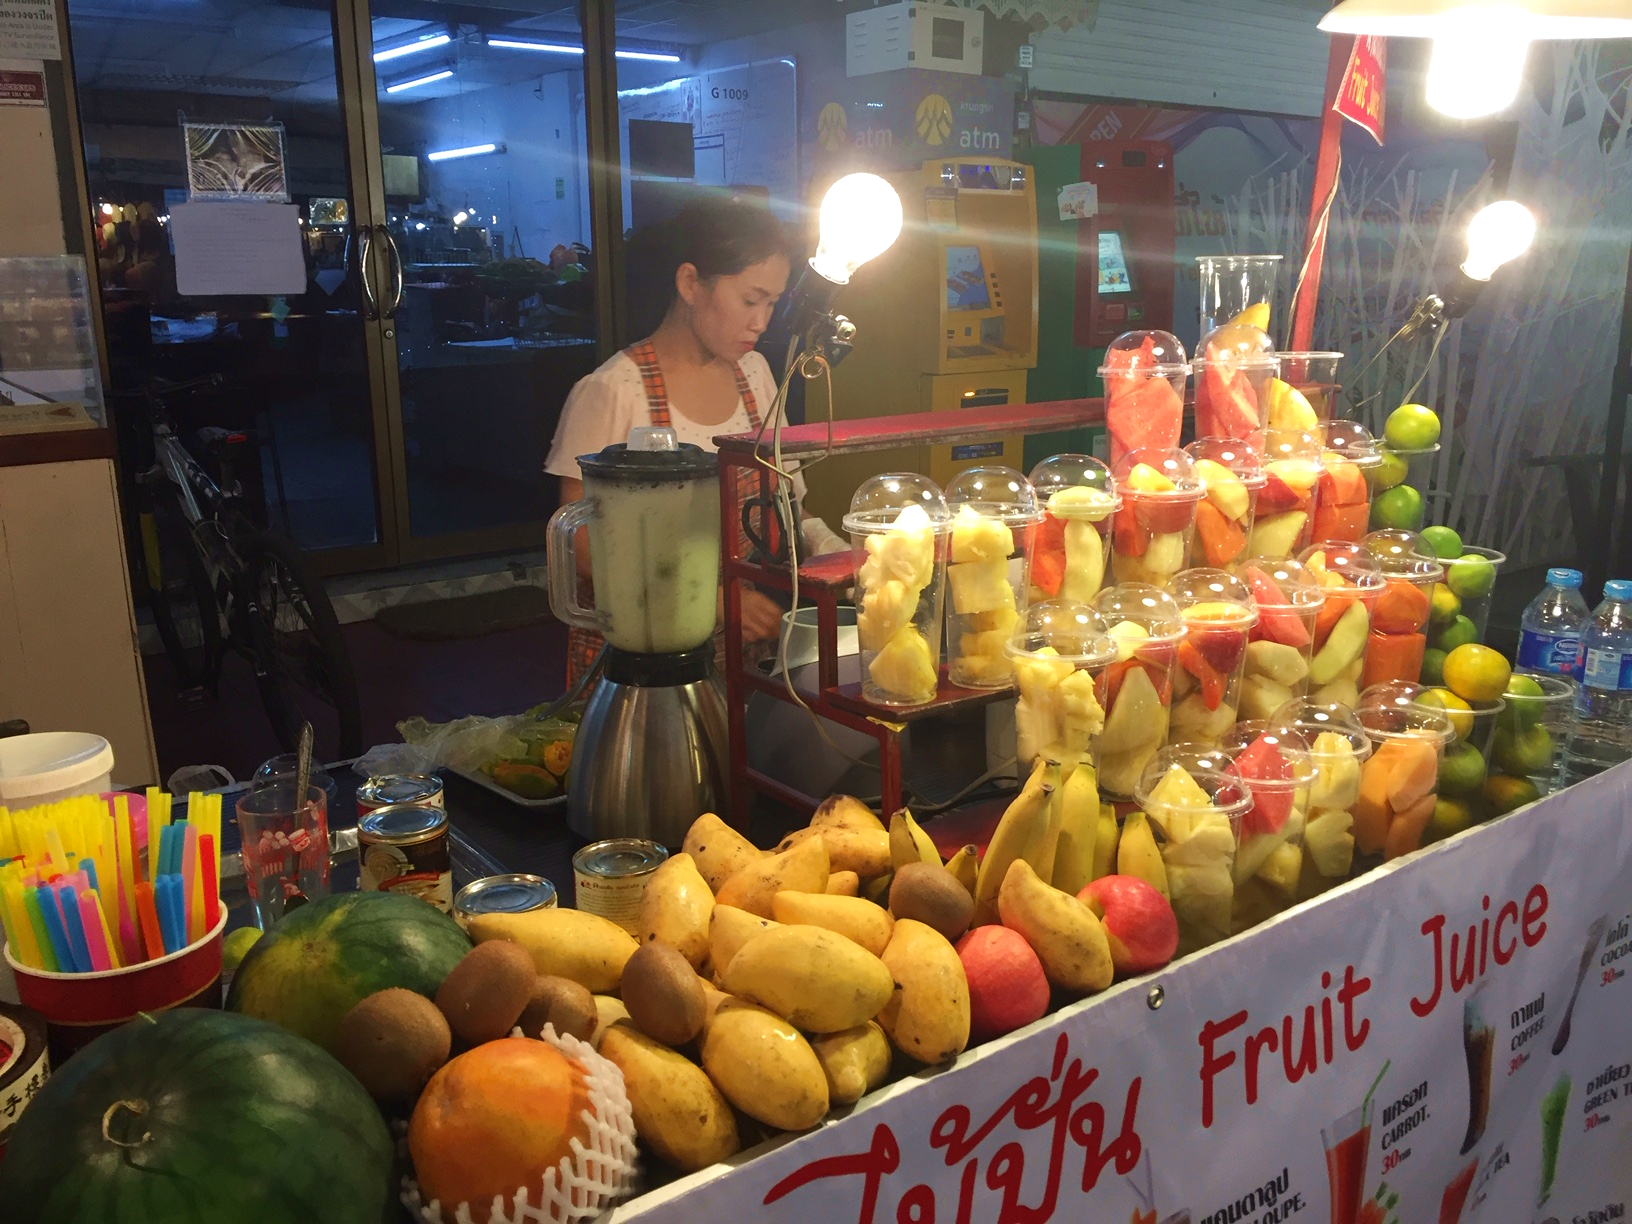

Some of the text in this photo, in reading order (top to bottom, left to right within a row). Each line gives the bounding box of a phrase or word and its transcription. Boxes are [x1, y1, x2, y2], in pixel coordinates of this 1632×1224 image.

[711, 87, 749, 101] G 1009
[855, 126, 893, 150] atm
[959, 126, 1000, 149] atm
[1198, 884, 1549, 1129] Fruit Juice
[1510, 1014, 1547, 1051] COFFEE
[1584, 1087, 1618, 1115] GREEN
[1381, 1104, 1431, 1150] CARROT.
